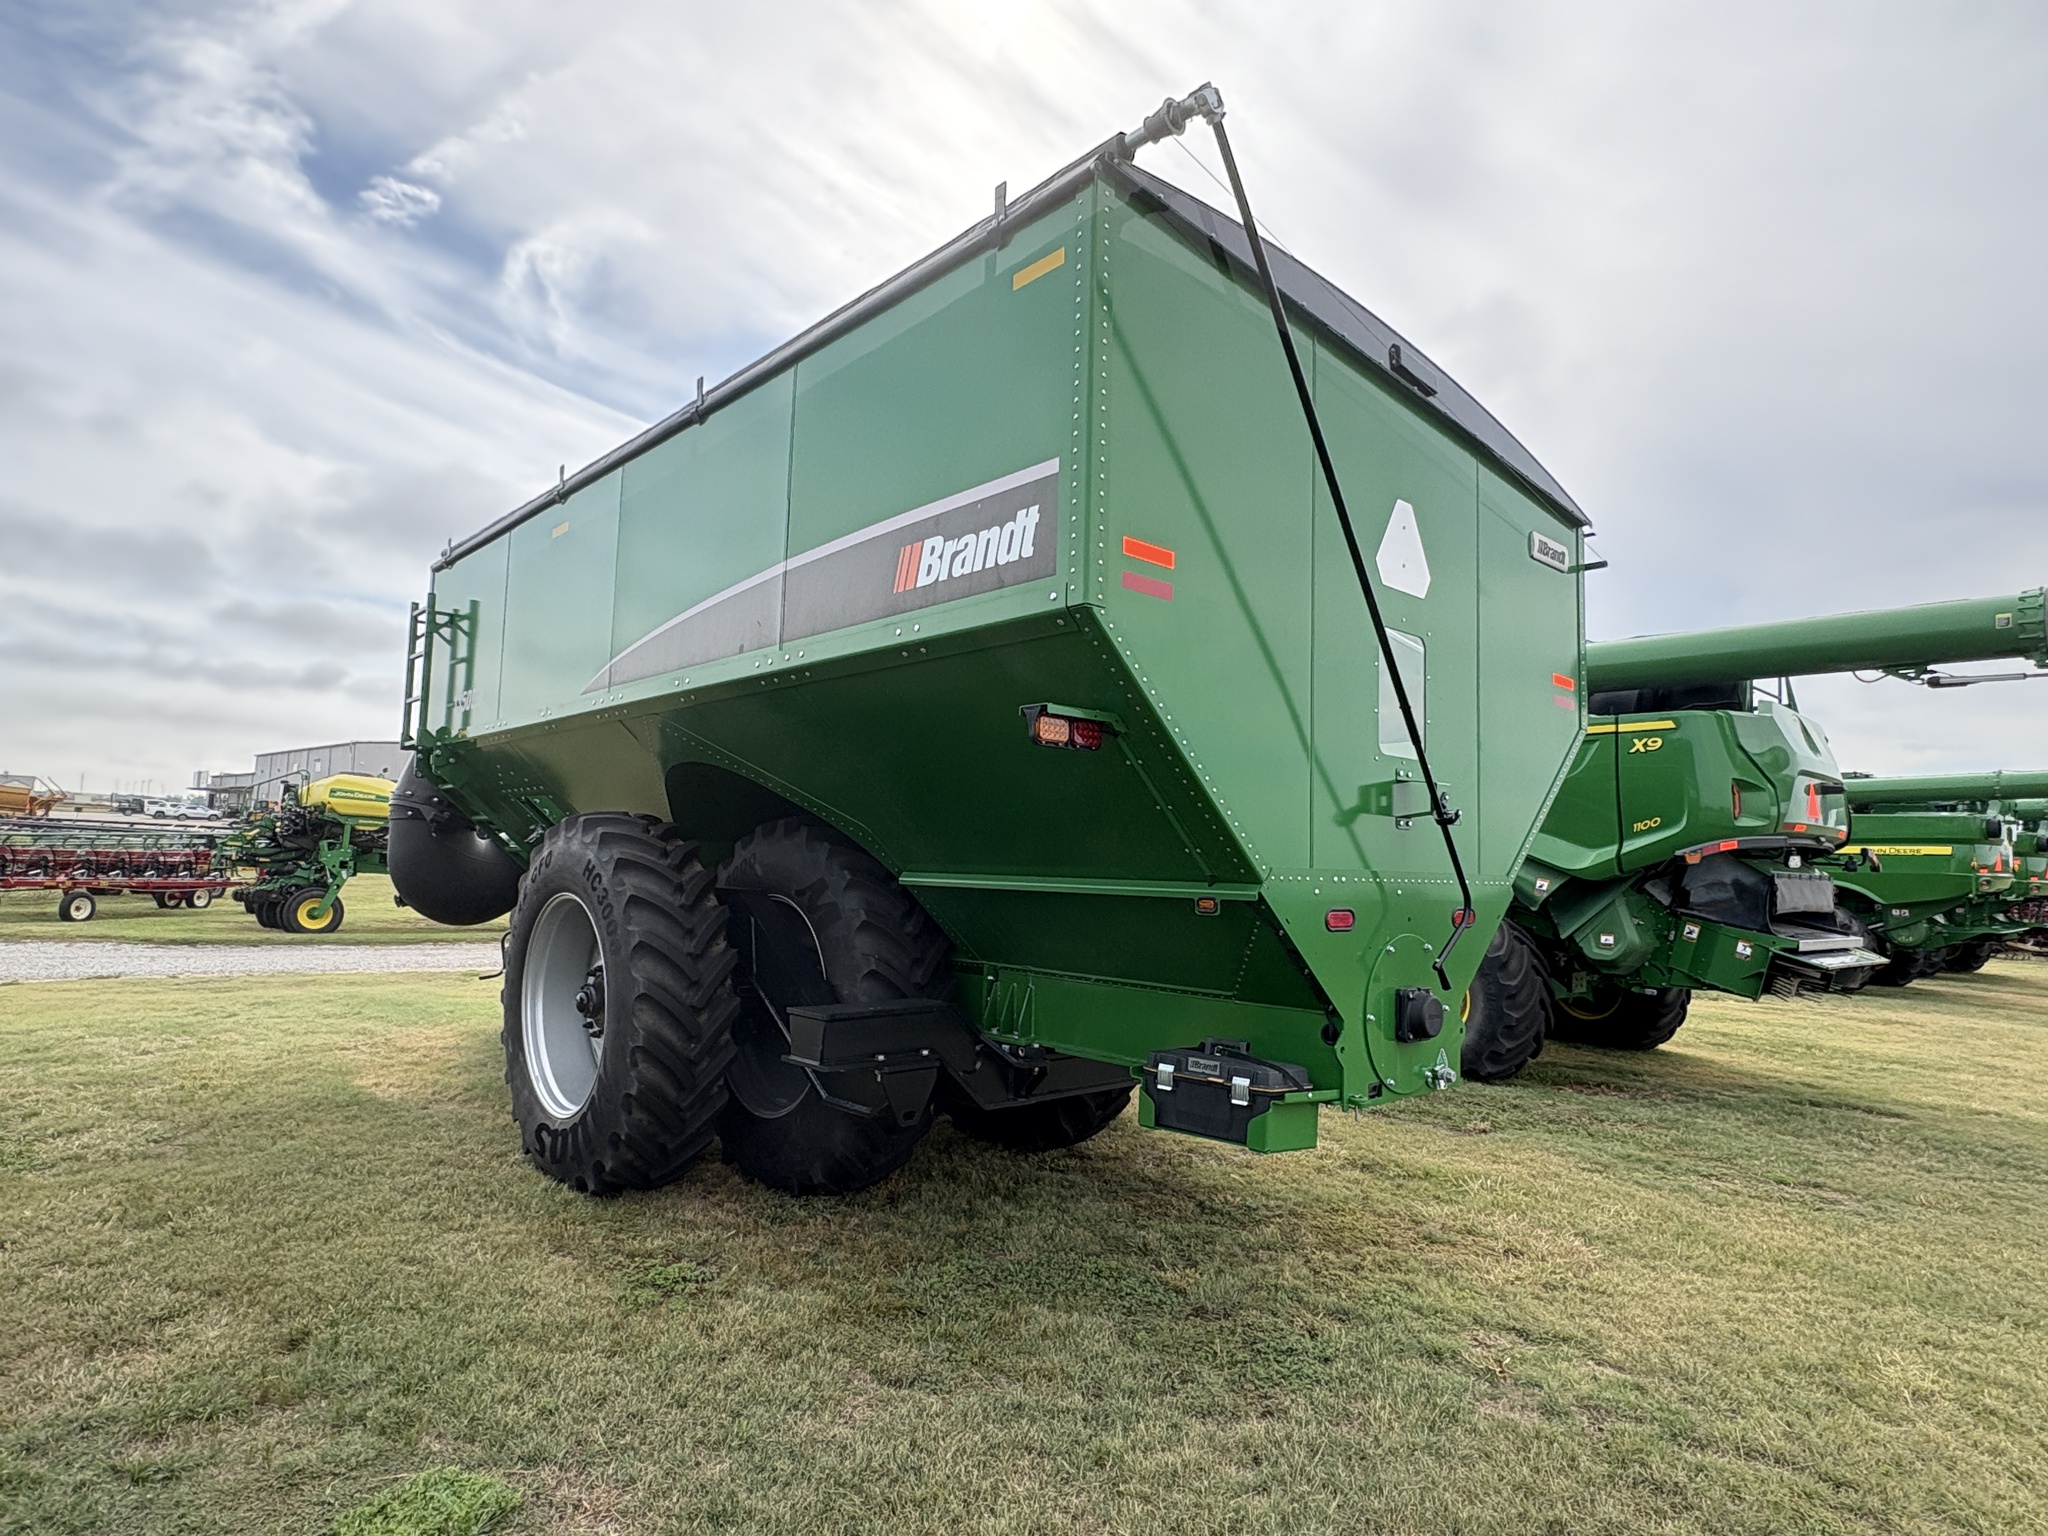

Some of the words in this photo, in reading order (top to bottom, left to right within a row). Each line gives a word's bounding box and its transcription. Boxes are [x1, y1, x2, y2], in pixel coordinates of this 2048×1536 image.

[916, 505, 1040, 588] Brandt
[1542, 541, 1566, 565] Brandt
[1629, 737, 1663, 753] X9
[1633, 817, 1661, 832] 1100
[1194, 1060, 1219, 1073] Brandt
